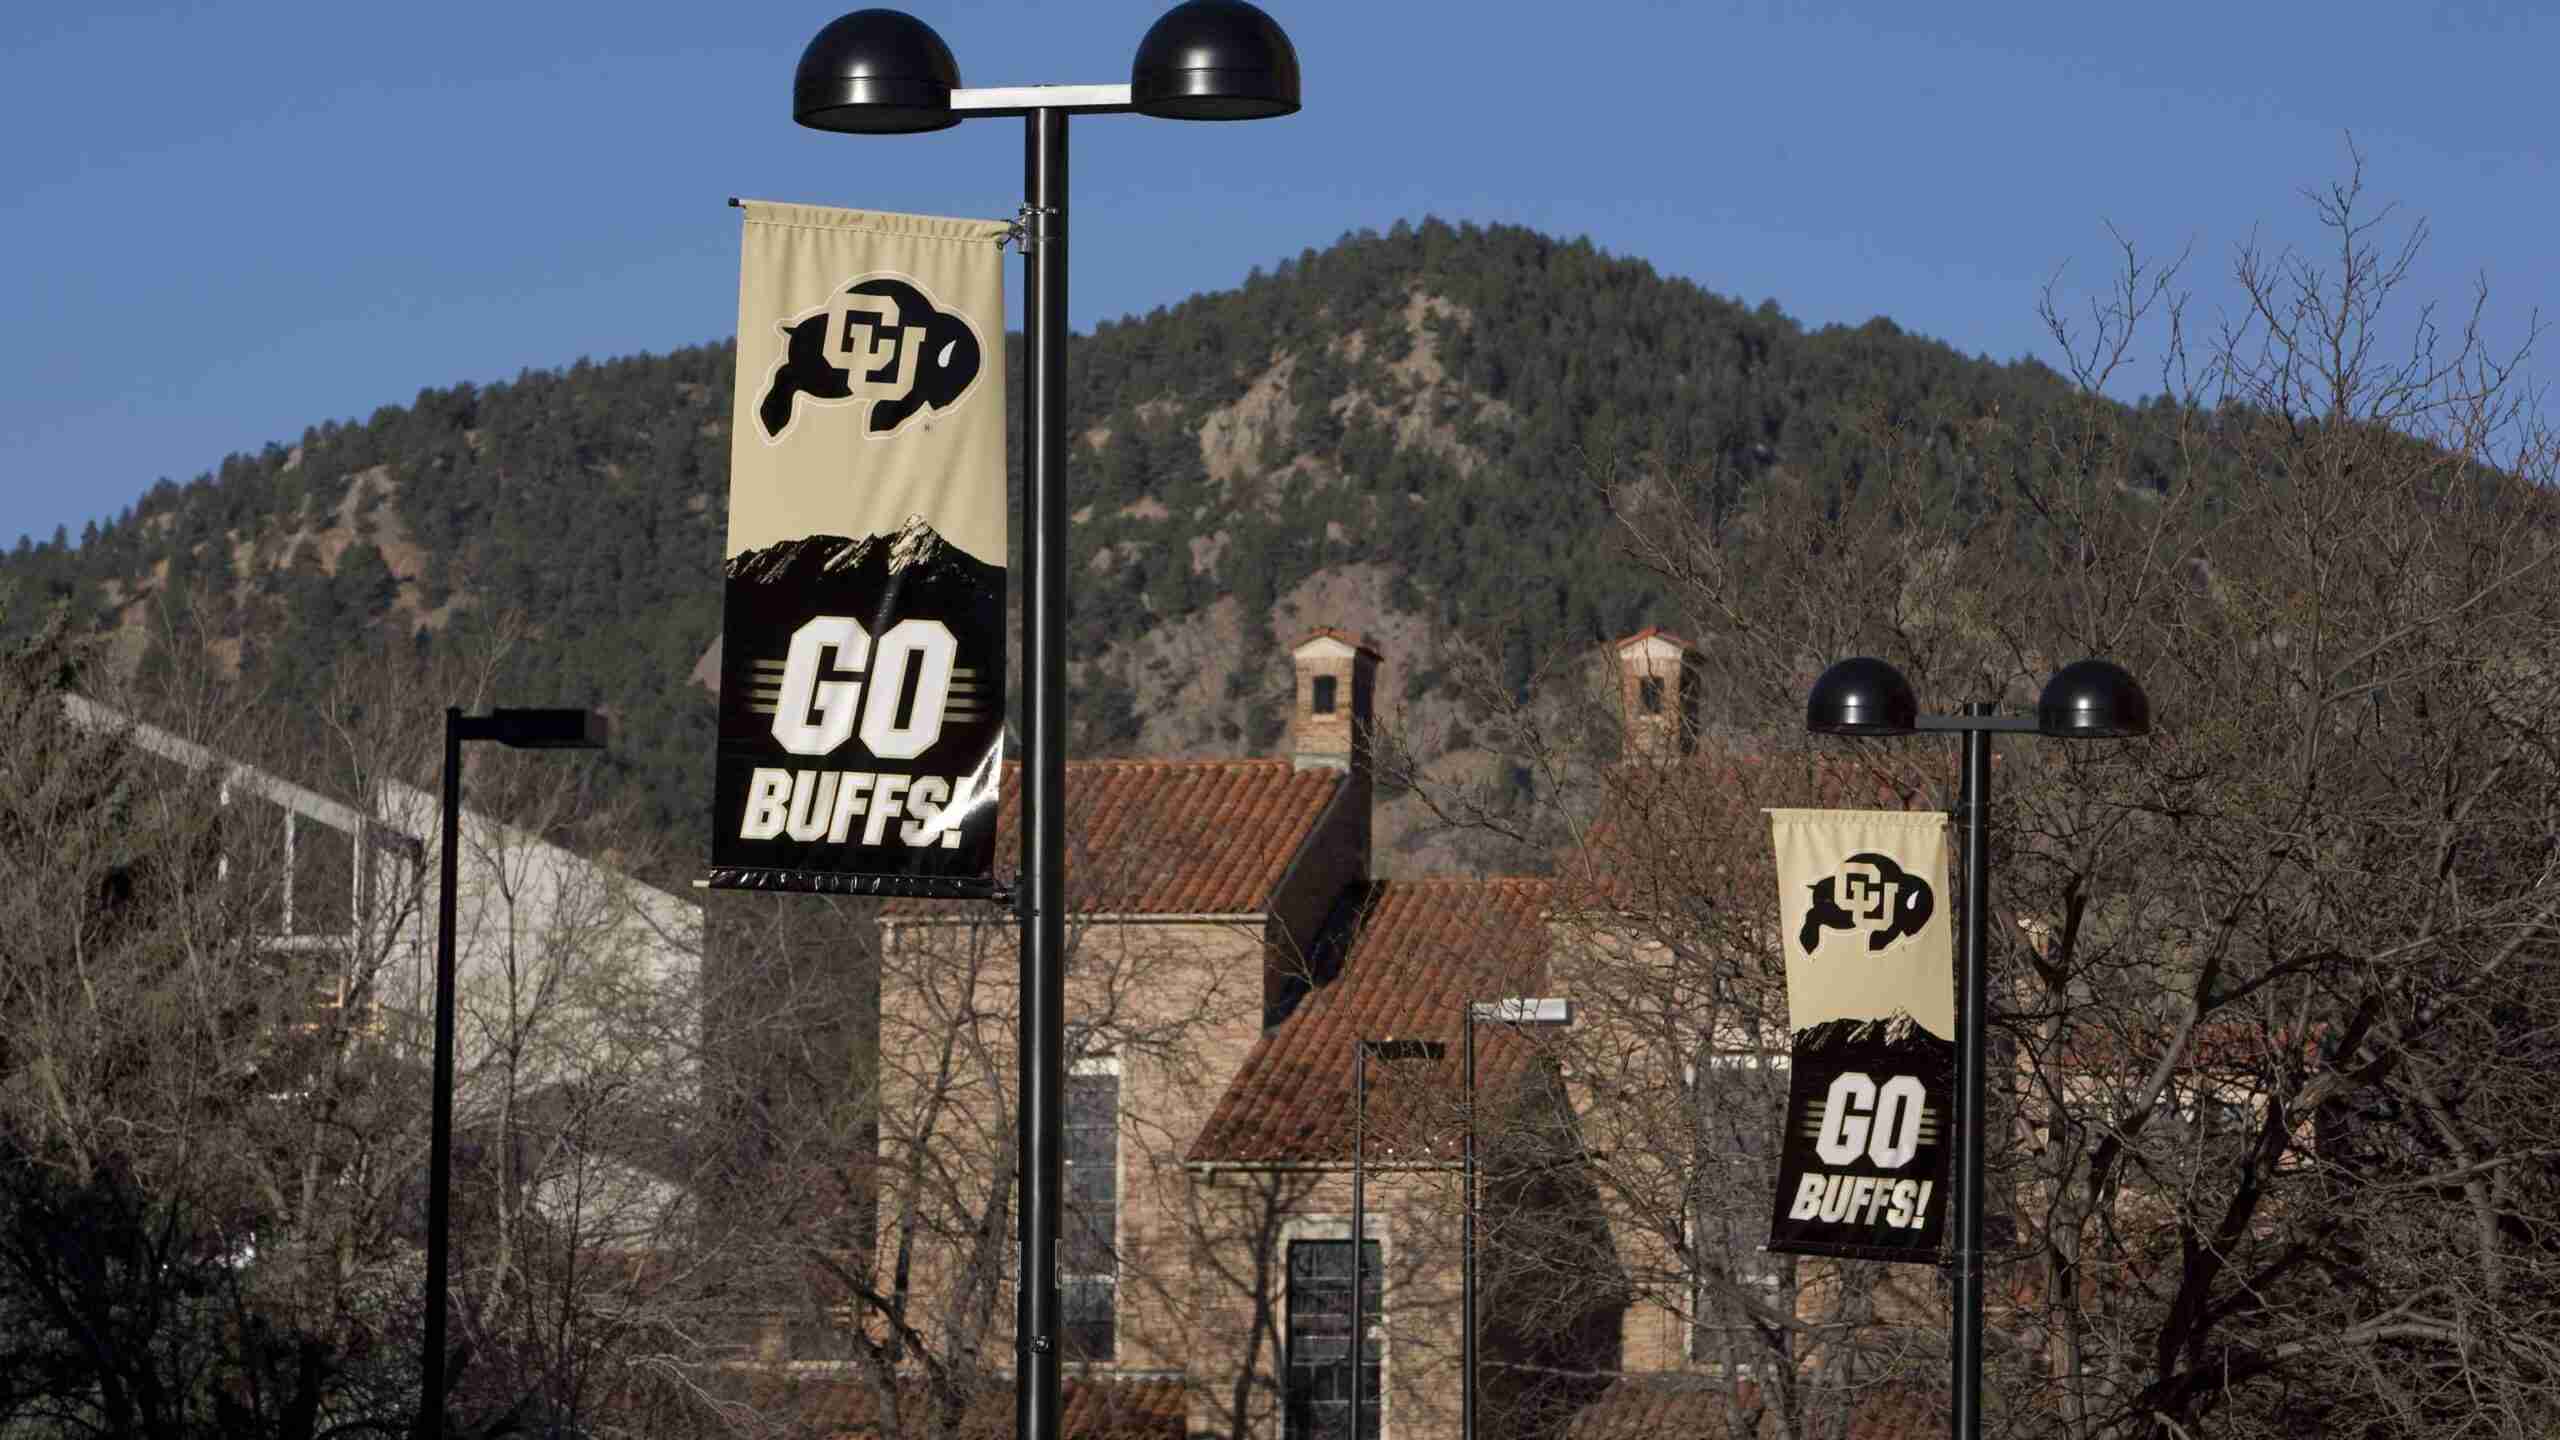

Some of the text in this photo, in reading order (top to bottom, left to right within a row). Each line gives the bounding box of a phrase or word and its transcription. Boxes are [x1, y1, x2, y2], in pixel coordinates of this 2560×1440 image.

[823, 293, 927, 401] CU
[771, 615, 958, 759] GO
[740, 767, 974, 849] BUFFS!
[1834, 862, 1899, 931] CU
[1816, 1072, 1926, 1168] GO
[1788, 1172, 1933, 1229] BUFFS!
